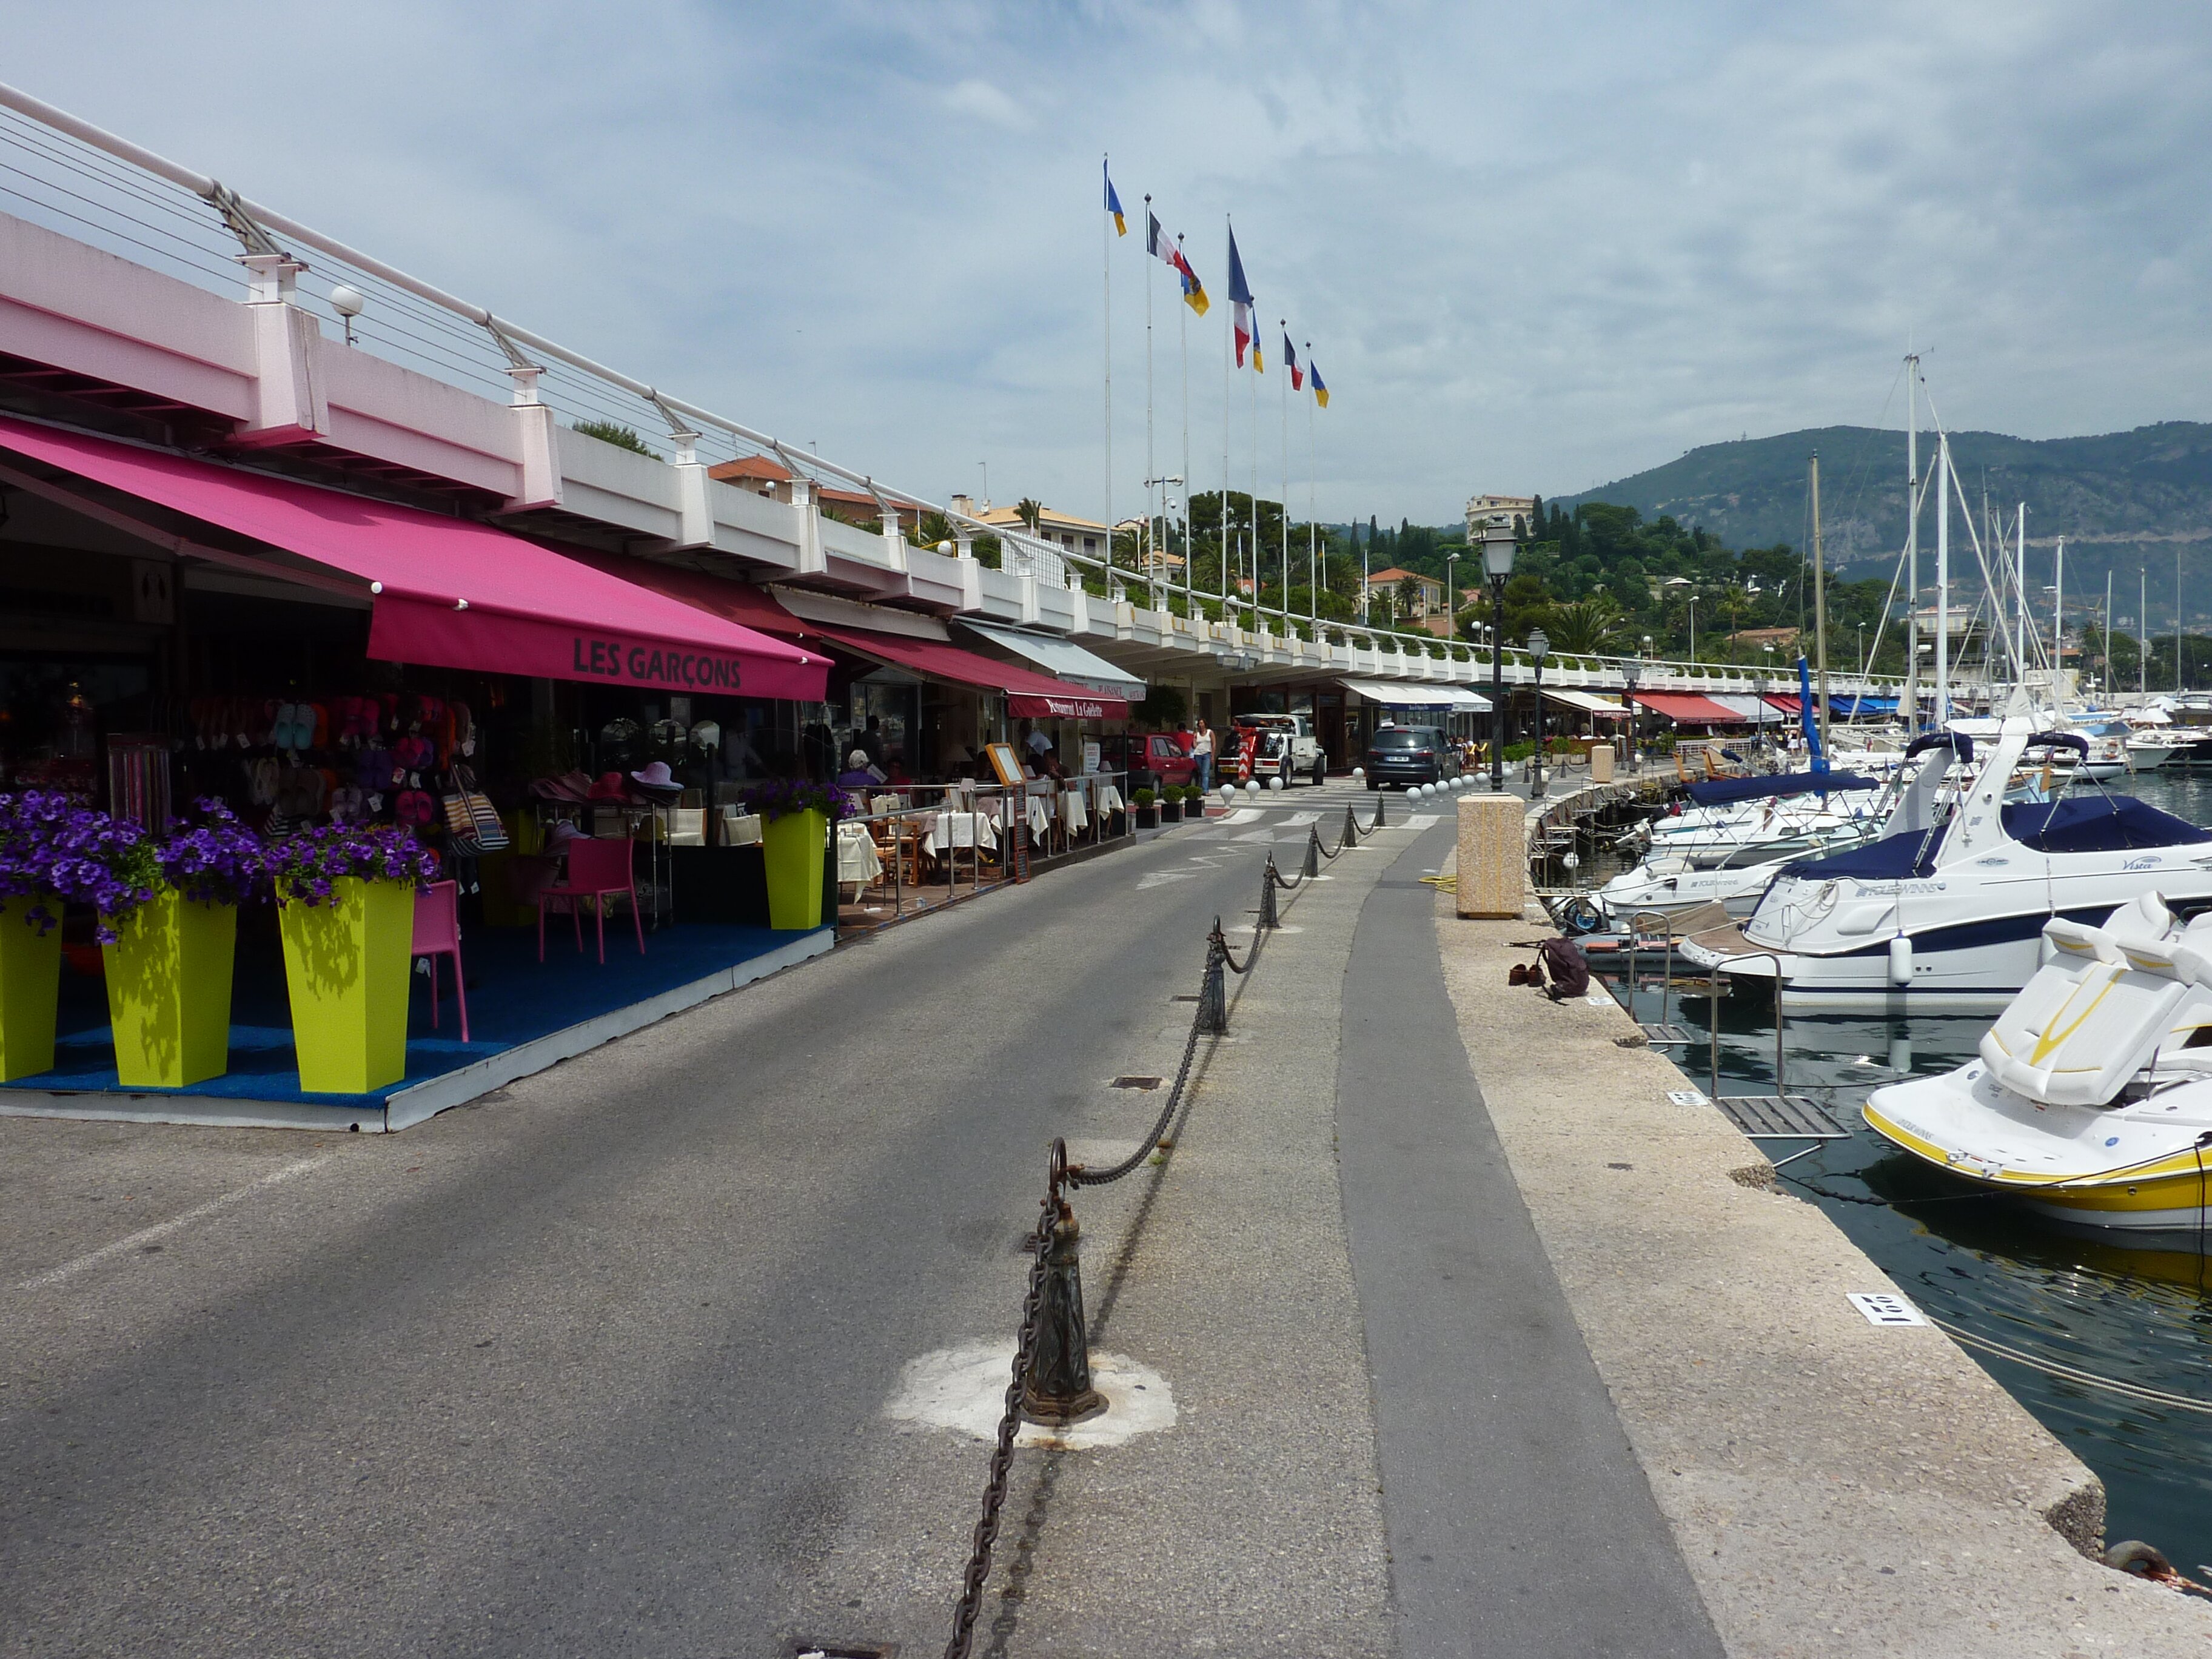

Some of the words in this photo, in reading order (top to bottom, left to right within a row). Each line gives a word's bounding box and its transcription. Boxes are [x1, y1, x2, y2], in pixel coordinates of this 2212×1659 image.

[574, 638, 620, 676] LES
[628, 647, 741, 689] GARÇONS
[1045, 699, 1075, 716] Restaurant
[1075, 702, 1083, 716] La
[2123, 856, 2161, 870] Vista
[1860, 1296, 1912, 1322] 221
